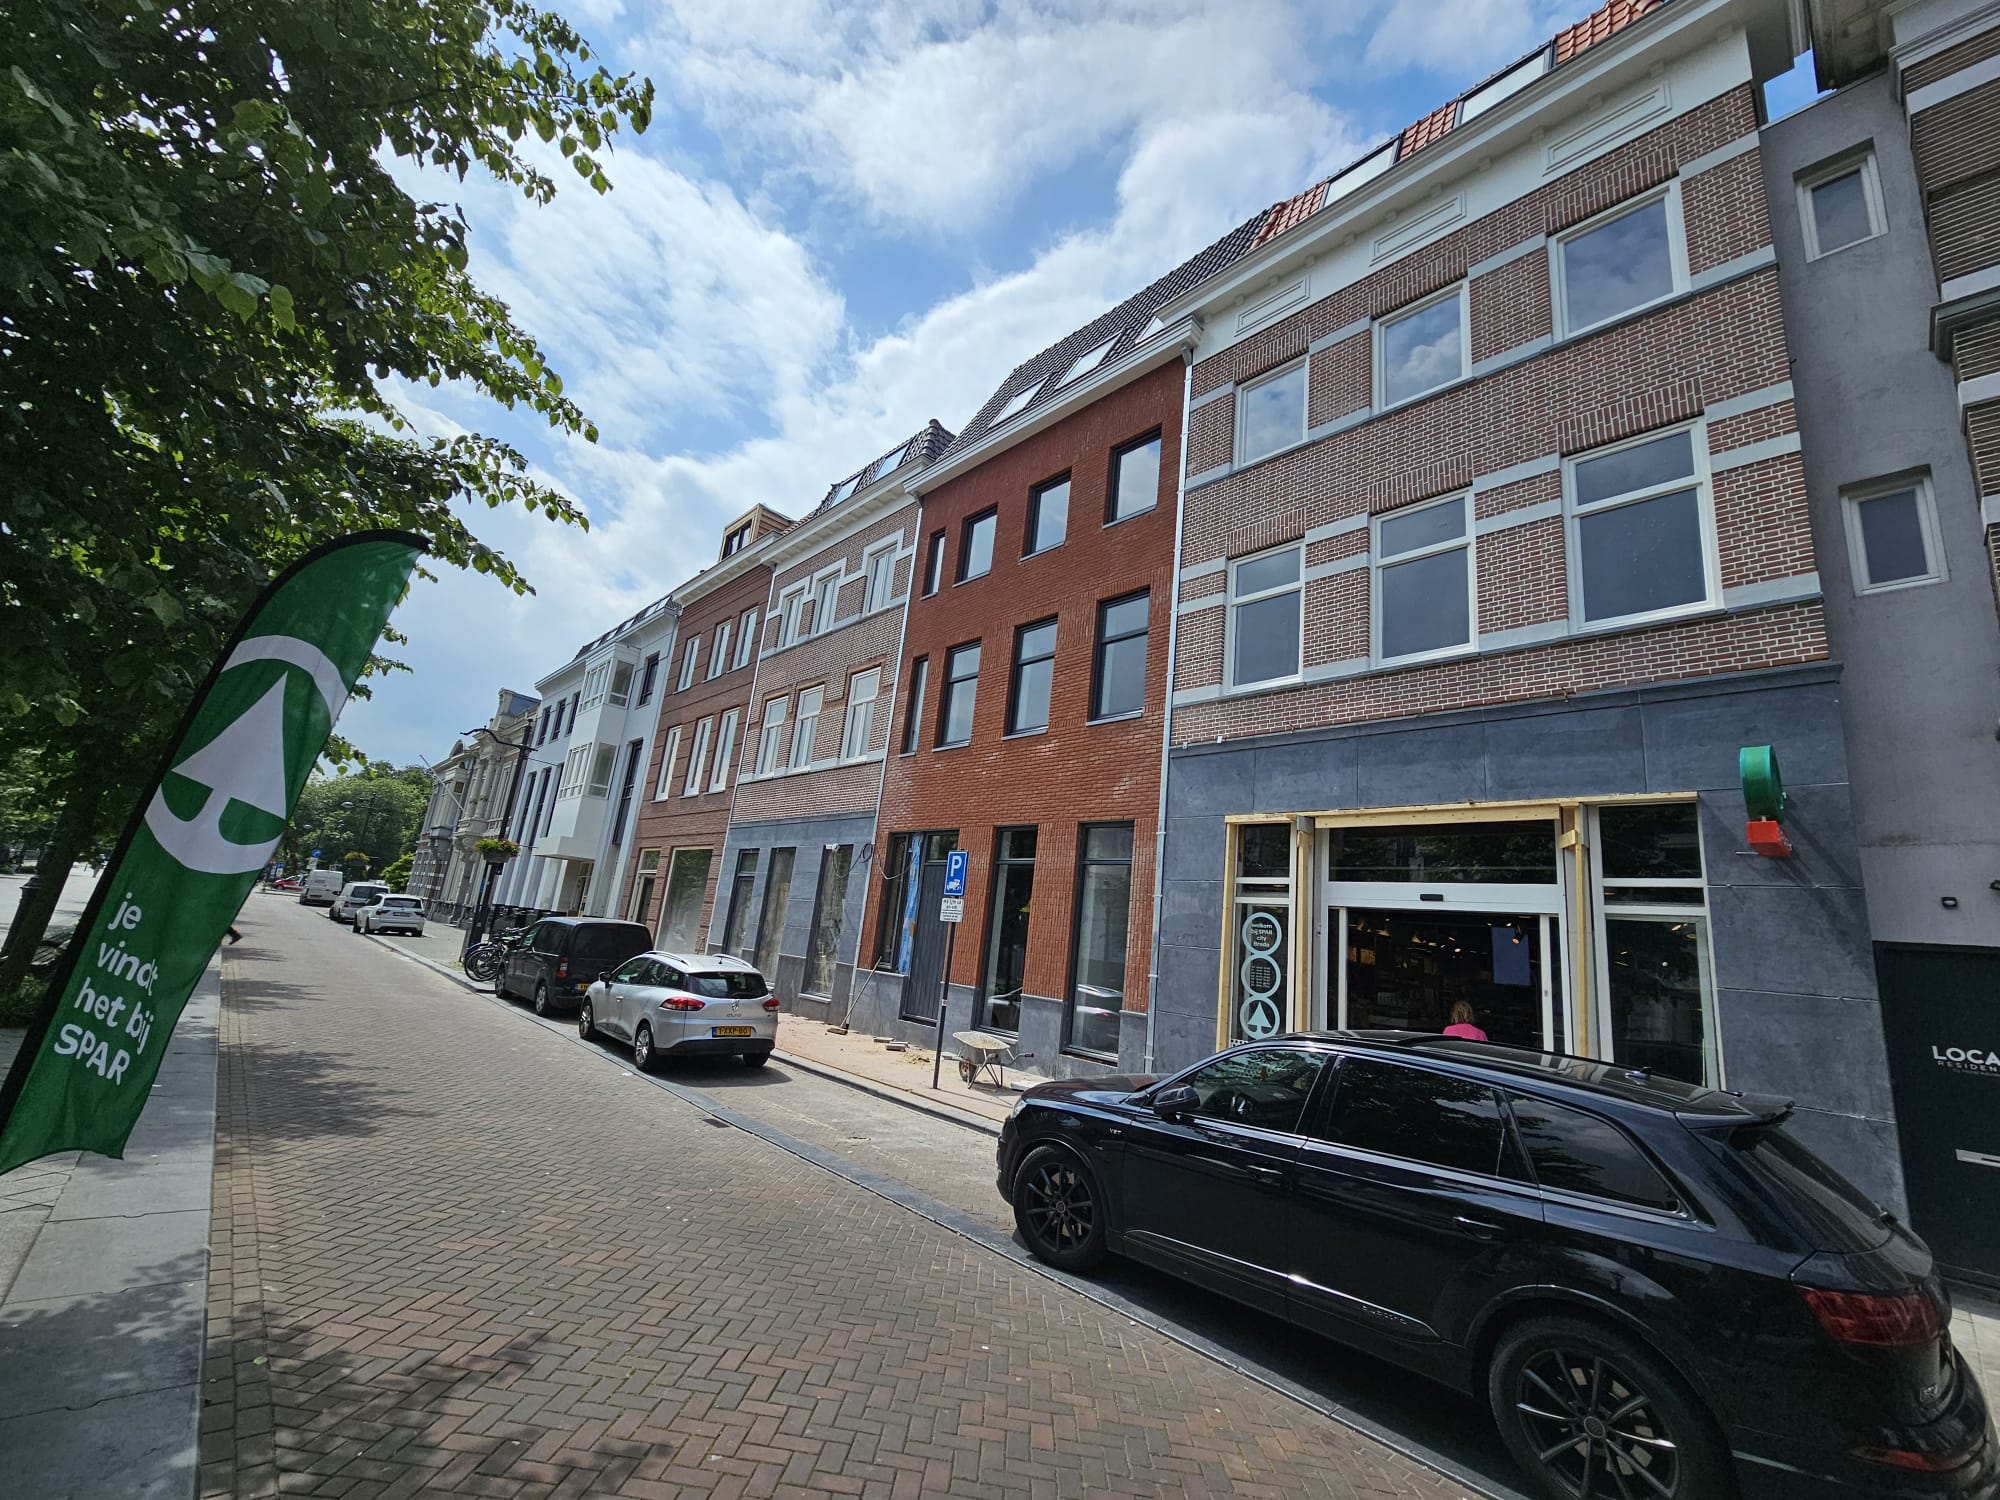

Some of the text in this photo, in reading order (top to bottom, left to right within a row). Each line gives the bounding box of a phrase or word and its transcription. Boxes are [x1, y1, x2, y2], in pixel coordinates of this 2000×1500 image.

[950, 855, 962, 877] P
[107, 892, 142, 930] je
[74, 976, 155, 1056] het bij
[54, 1023, 131, 1086] SPAR
